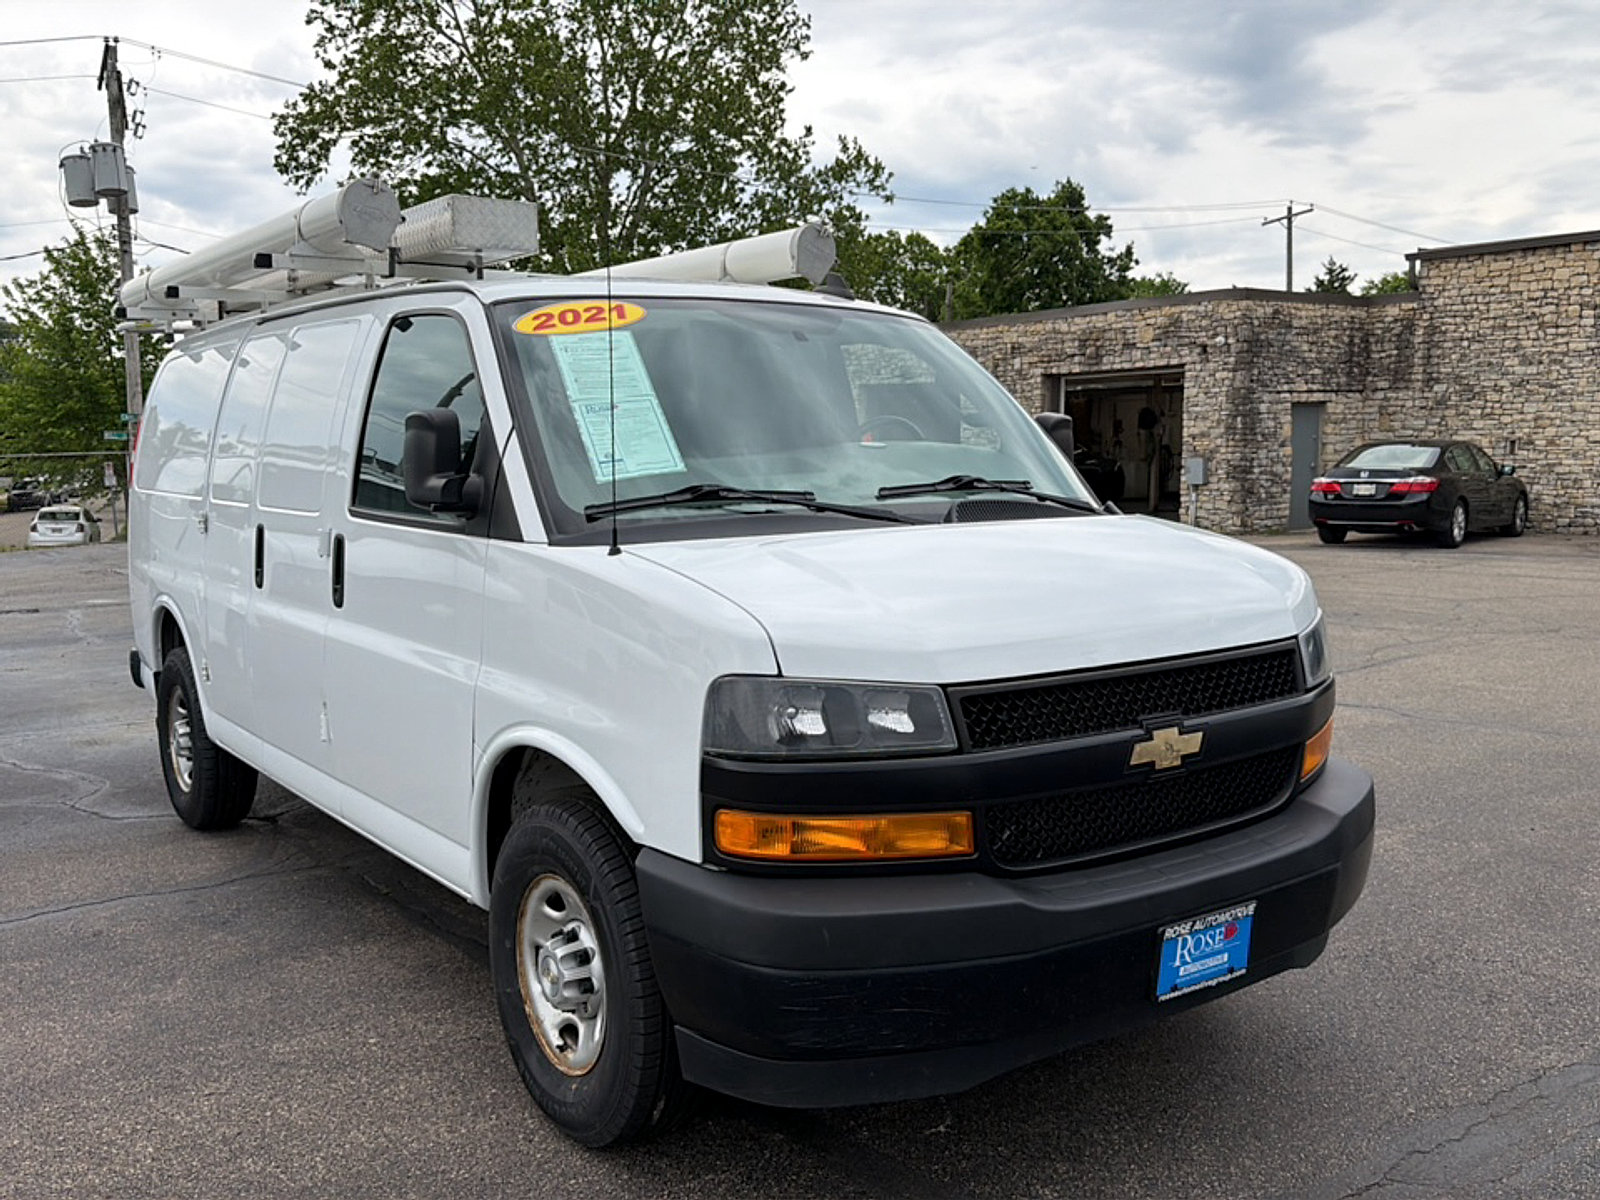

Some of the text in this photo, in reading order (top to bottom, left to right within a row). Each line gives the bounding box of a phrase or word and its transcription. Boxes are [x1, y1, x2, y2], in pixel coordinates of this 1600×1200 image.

[531, 304, 627, 332] 2021
[1164, 904, 1257, 939] ROSE AUTOMOTIVE
[1174, 928, 1225, 967] ROSE
